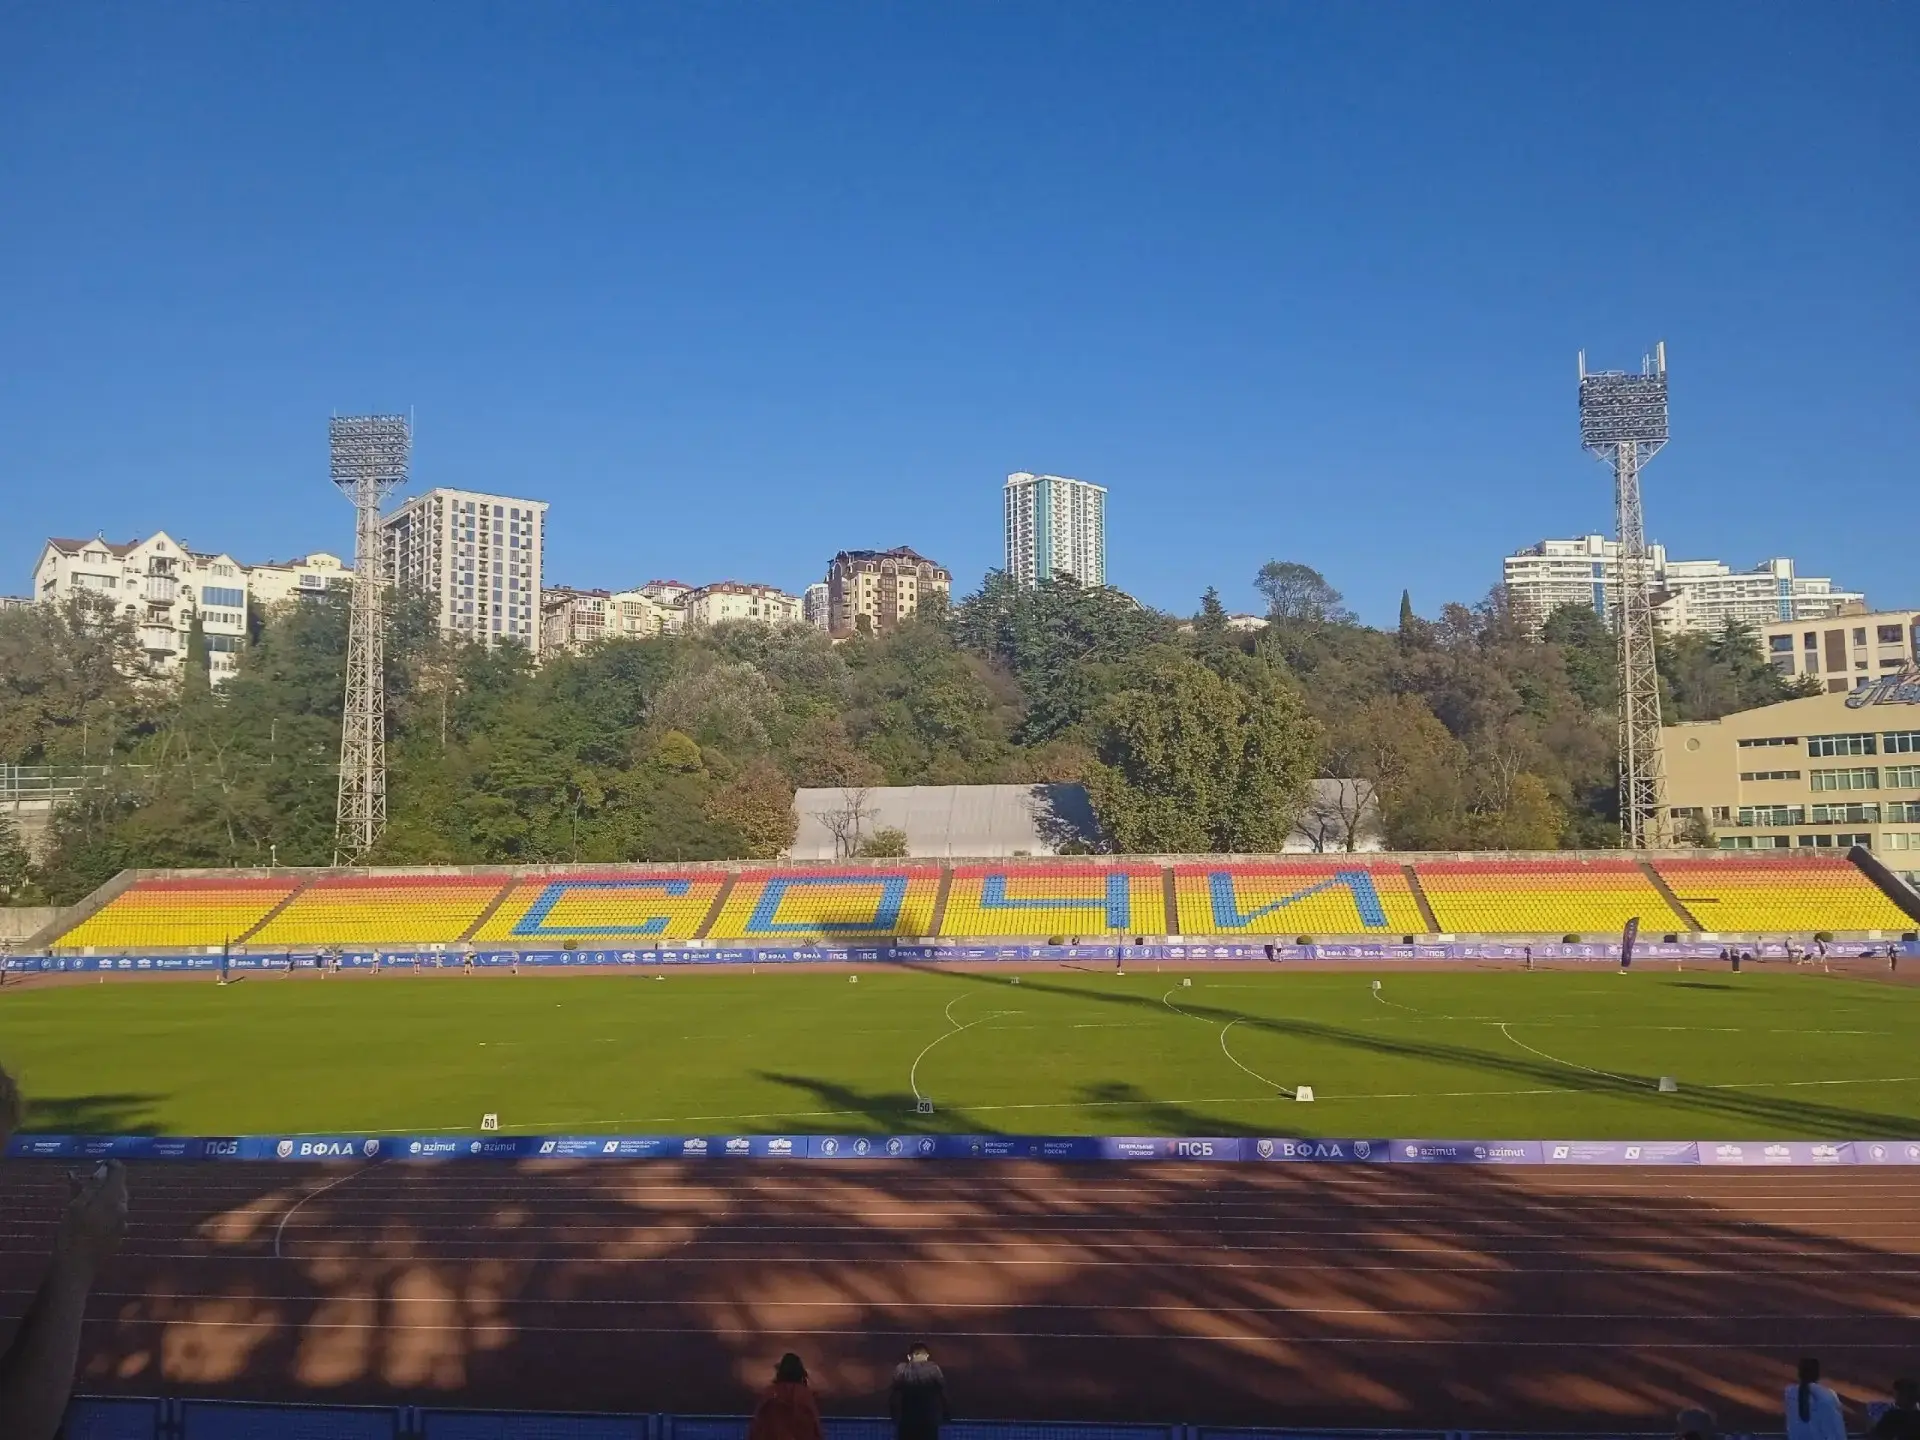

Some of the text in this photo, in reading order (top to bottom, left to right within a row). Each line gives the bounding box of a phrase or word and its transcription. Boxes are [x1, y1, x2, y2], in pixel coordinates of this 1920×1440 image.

[511, 871, 1391, 937] СОЧИ
[862, 952, 877, 960] ПСБ
[919, 1102, 930, 1112] 50
[484, 1117, 495, 1128] 60
[205, 1141, 238, 1155] ПСБ
[300, 1142, 354, 1156] ВФЛА
[423, 1141, 456, 1152] azimut
[484, 1142, 516, 1152] azimut
[1178, 1142, 1213, 1156] ПСБ
[1283, 1143, 1343, 1157] ВФЛА
[1420, 1146, 1457, 1156] azimut
[1489, 1148, 1525, 1158] azimut
